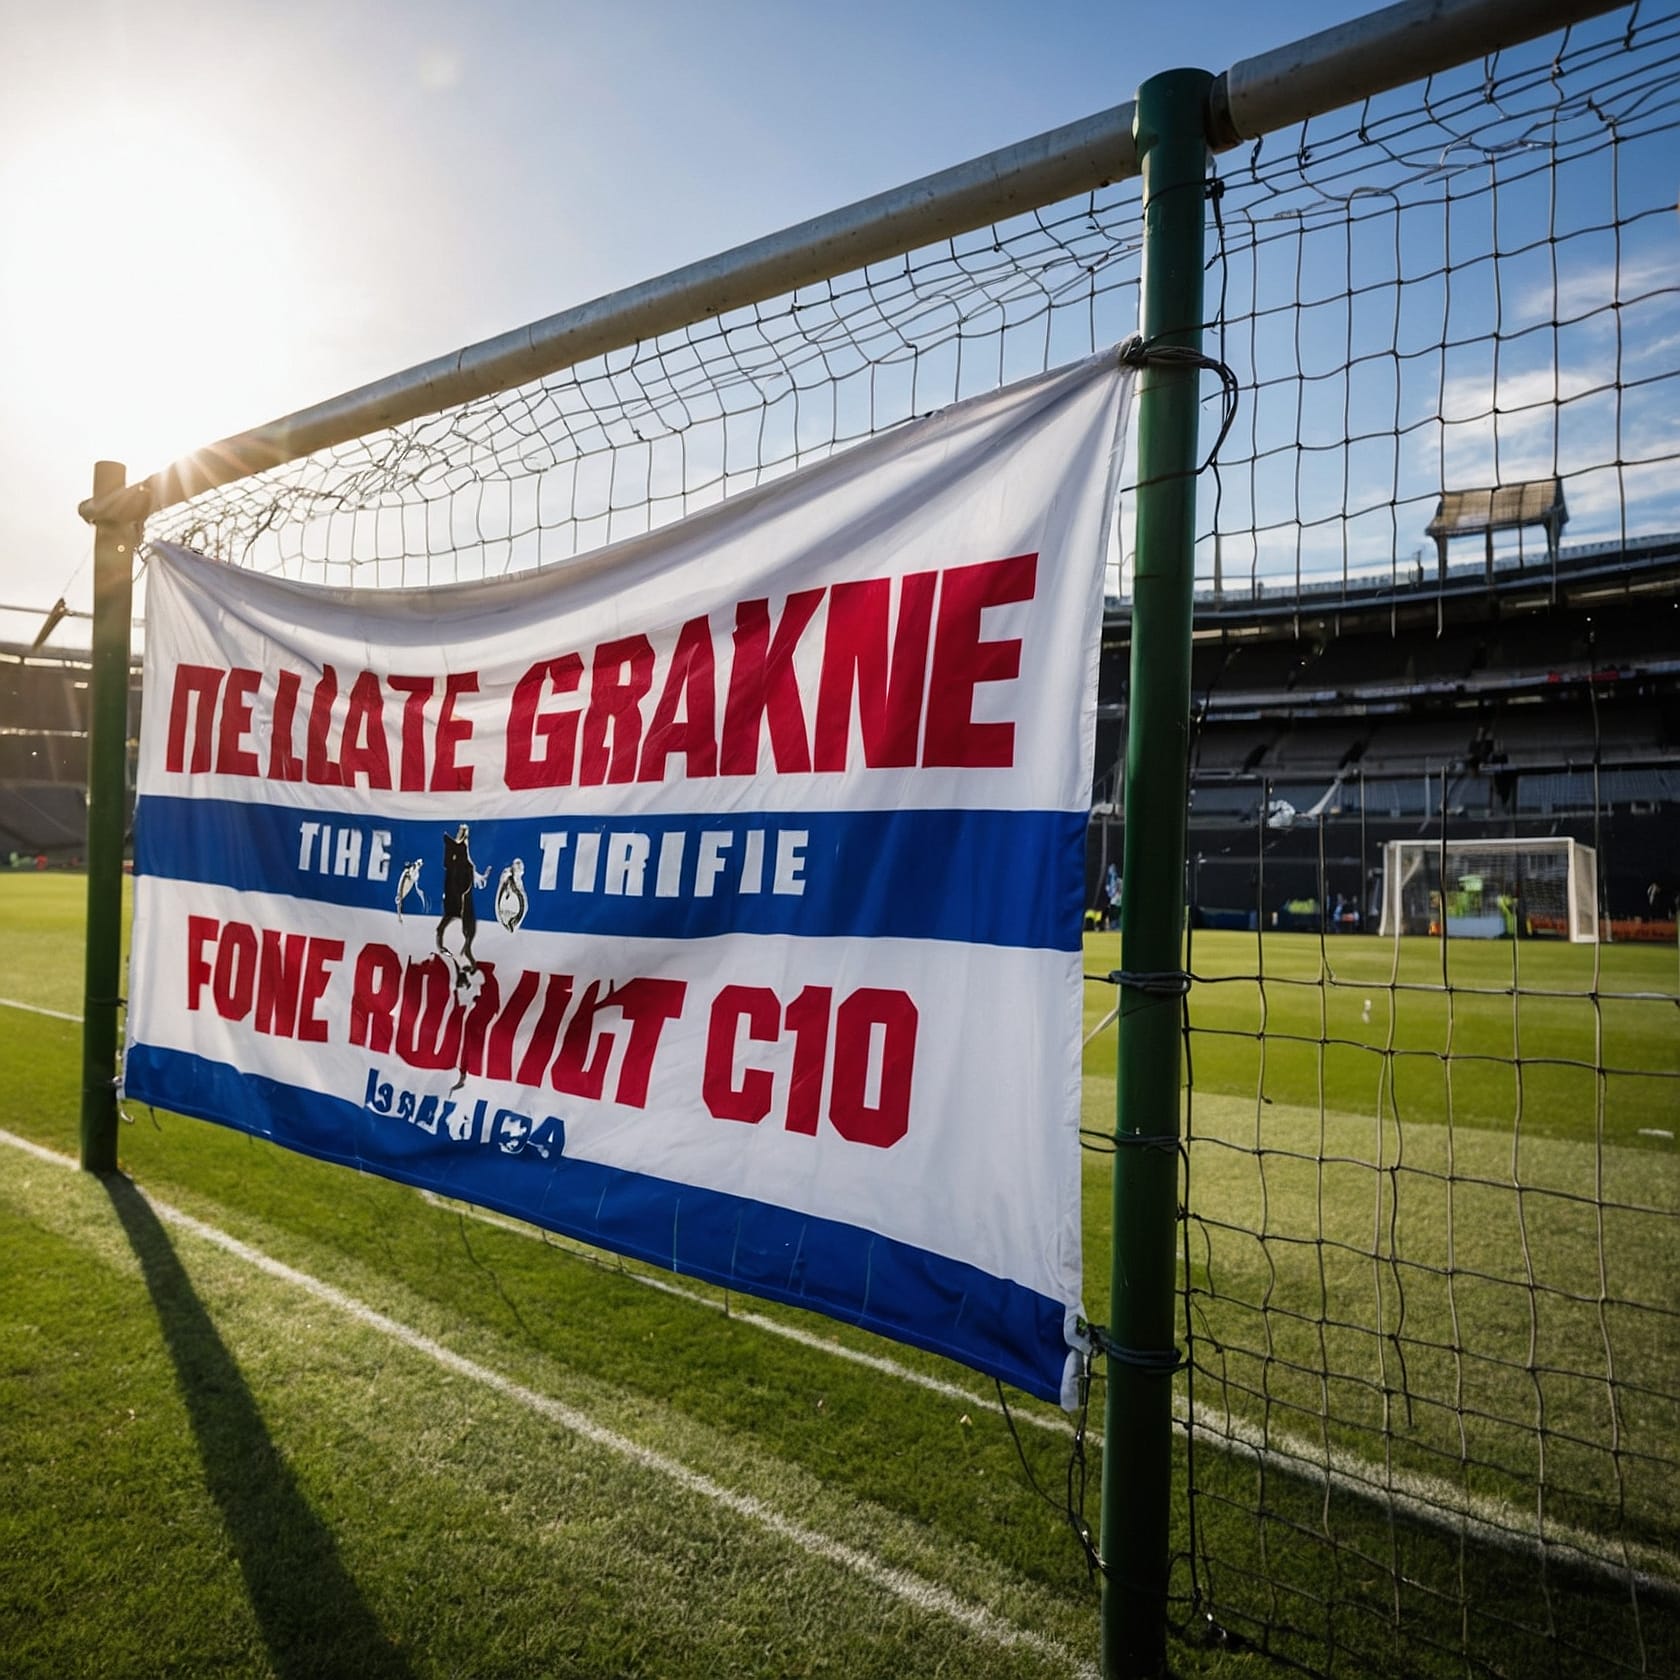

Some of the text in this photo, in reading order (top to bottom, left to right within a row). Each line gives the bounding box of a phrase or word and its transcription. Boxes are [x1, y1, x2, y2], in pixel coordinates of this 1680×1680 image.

[503, 554, 1038, 792] GRAKNE
[539, 829, 810, 897] TIRIFIE
[187, 914, 345, 1043] FONE
[701, 984, 919, 1149] C10
